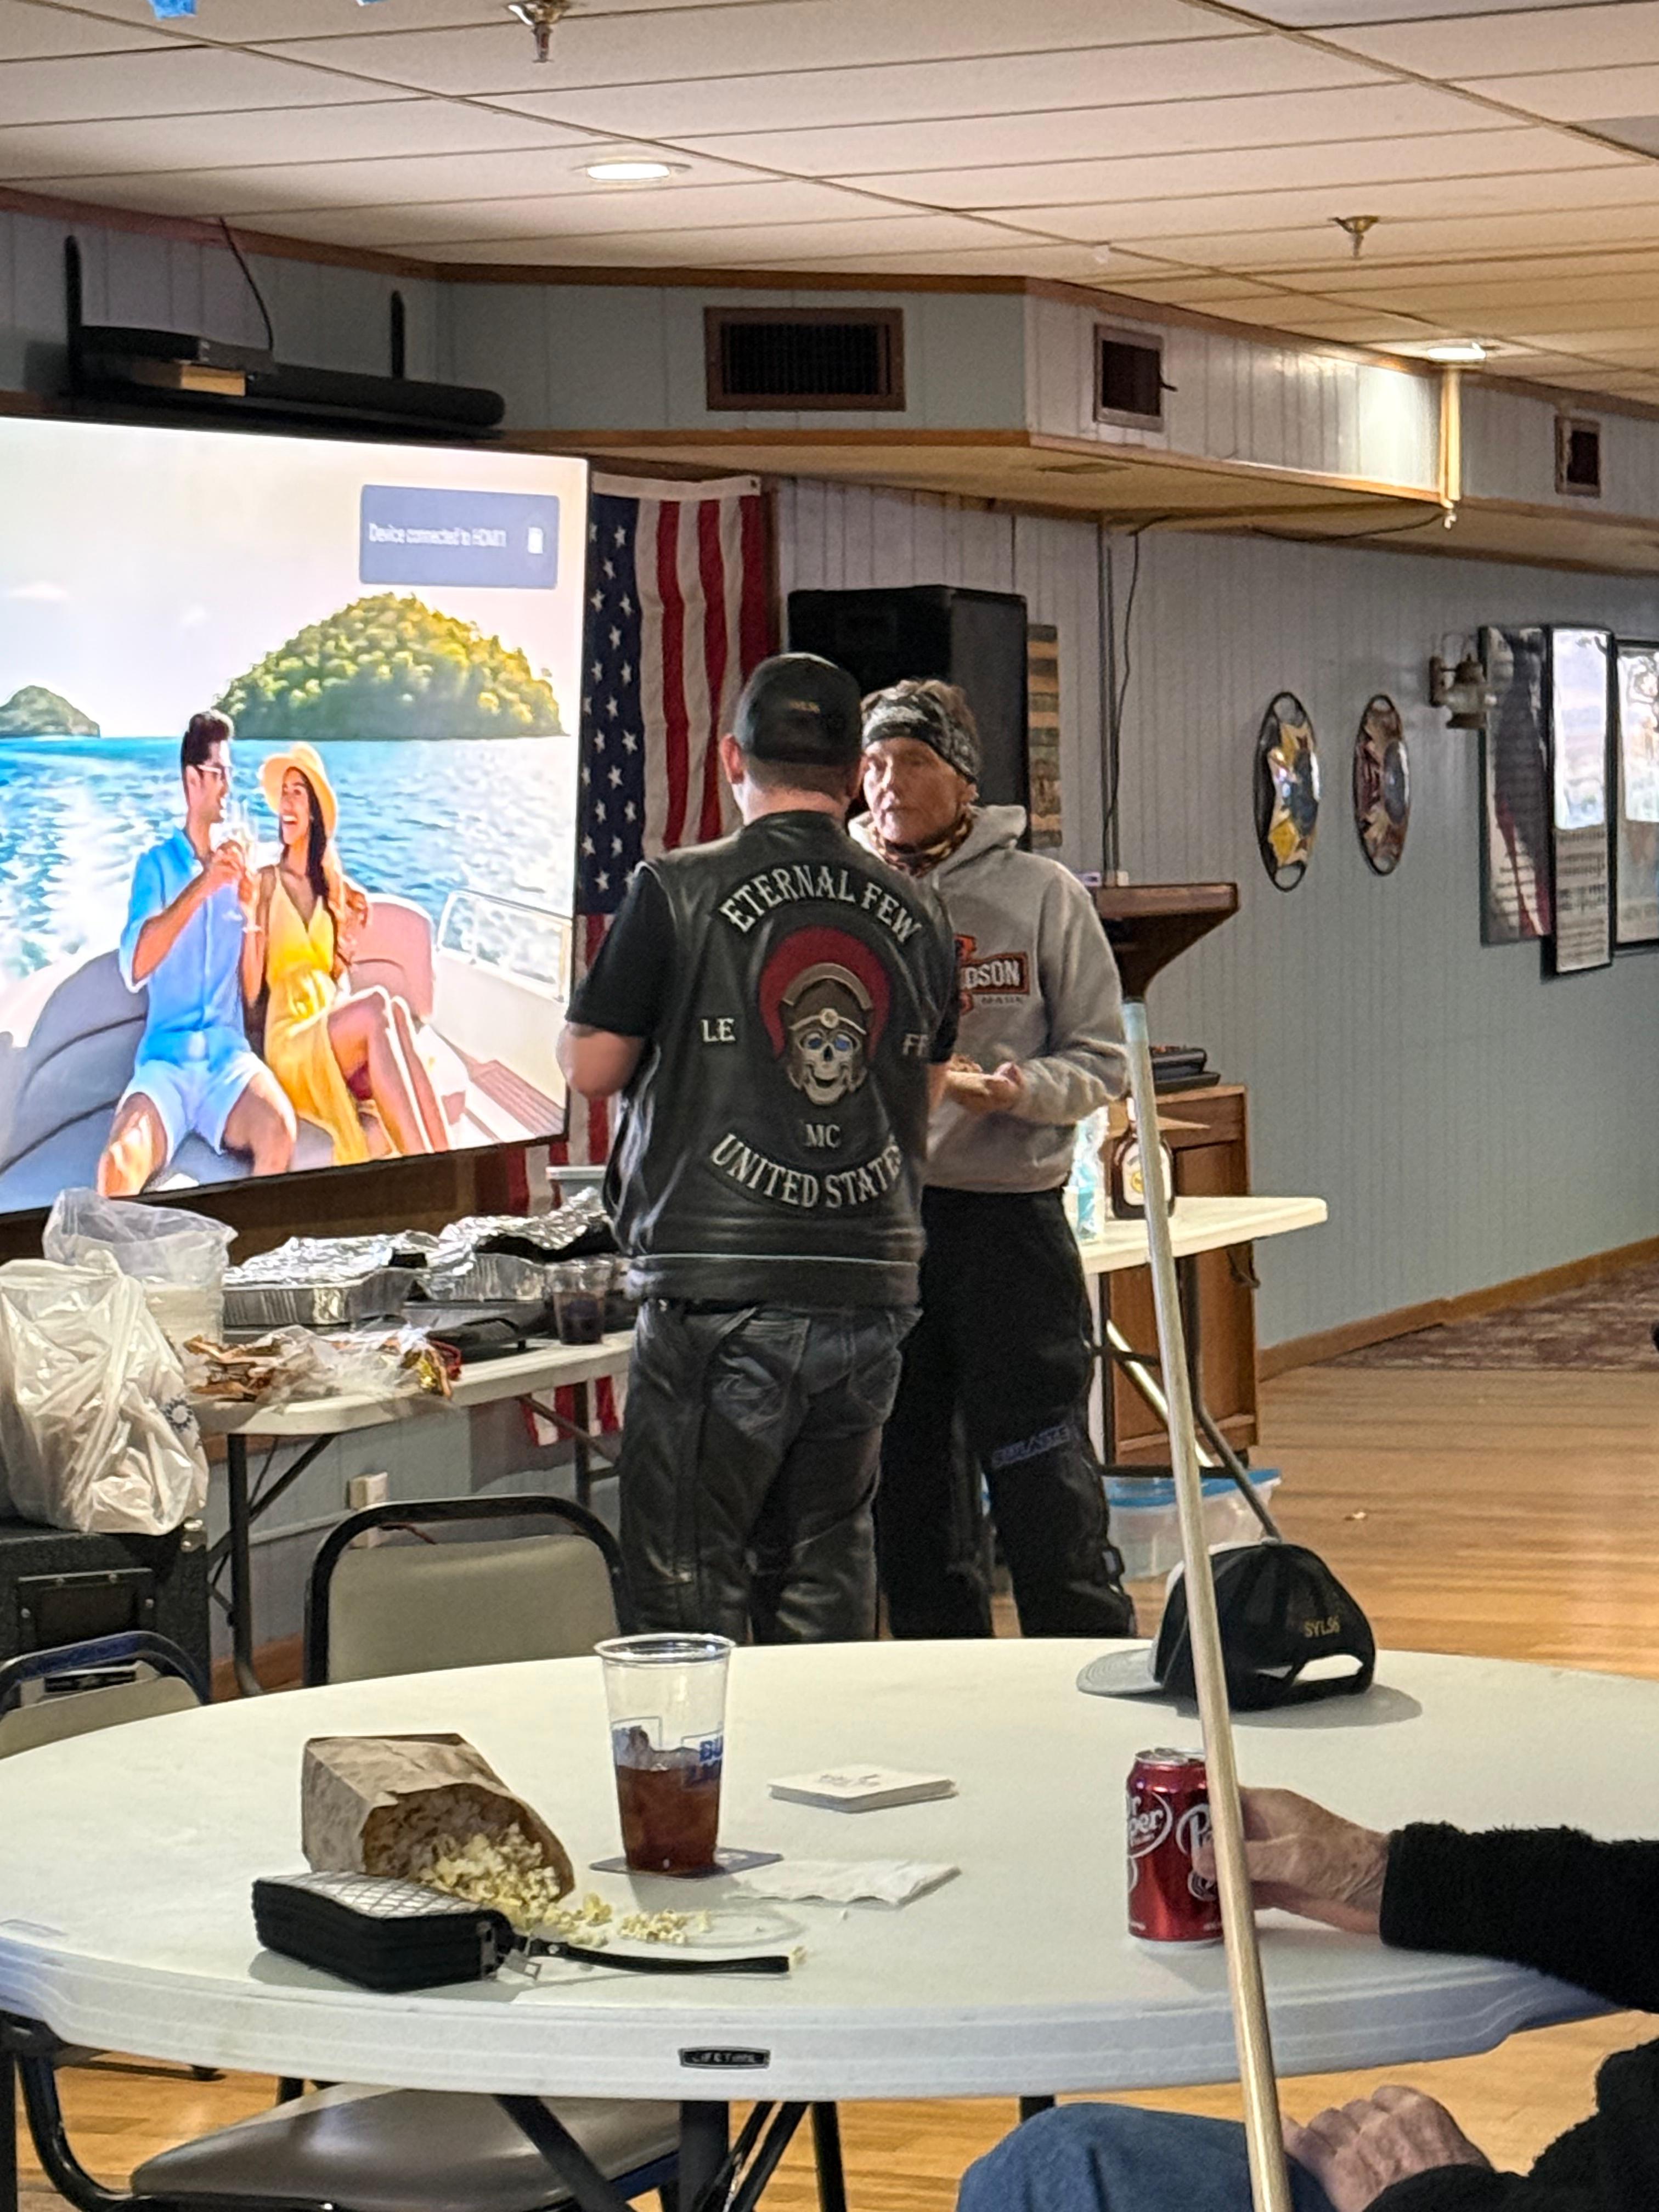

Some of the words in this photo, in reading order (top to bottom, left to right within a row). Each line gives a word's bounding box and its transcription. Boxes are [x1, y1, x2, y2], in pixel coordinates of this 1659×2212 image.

[719, 864, 856, 933] ETERNAL
[861, 882, 922, 943] FEW
[702, 1018, 736, 1042] LE
[804, 1124, 841, 1148] MC
[712, 1132, 820, 1207] UNITED
[825, 1133, 901, 1209] STATE
